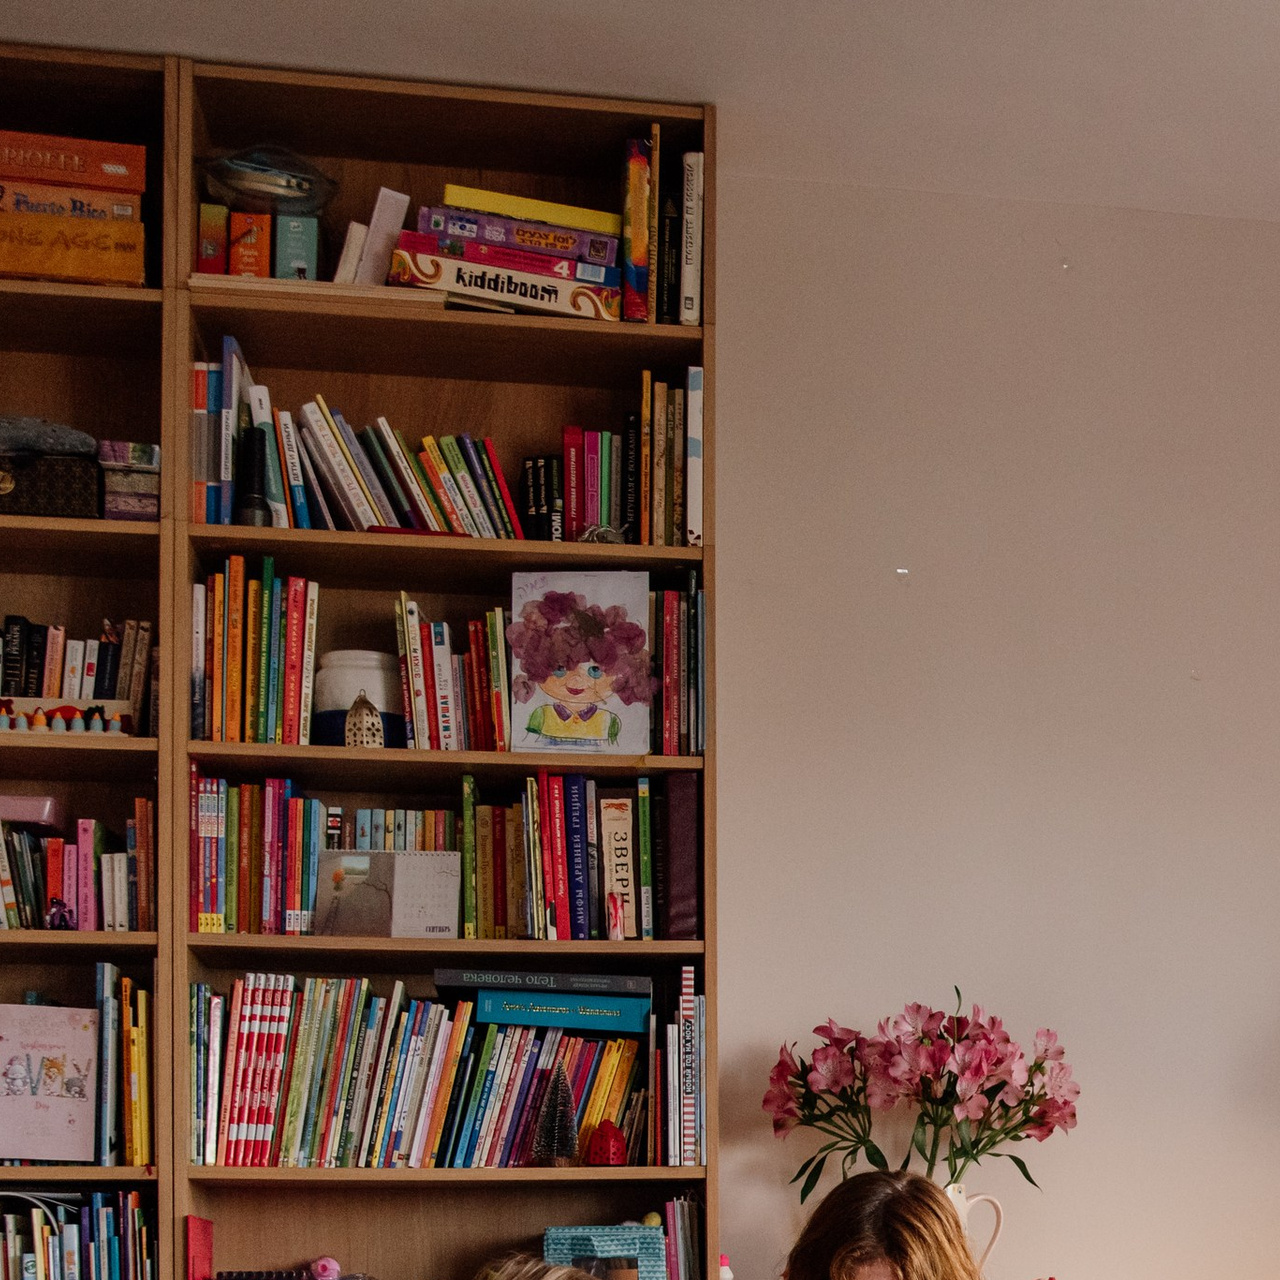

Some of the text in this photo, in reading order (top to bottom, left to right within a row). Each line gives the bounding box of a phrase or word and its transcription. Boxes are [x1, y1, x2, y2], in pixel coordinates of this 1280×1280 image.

[14, 191, 108, 219] Puerto Rico
[553, 260, 570, 277] 4
[283, 423, 294, 453] ДЕНЬГИ
[627, 429, 636, 472] ВОЛКАМИ
[290, 462, 300, 481] ДЕТИ
[627, 481, 636, 522] БЕГУЩАЯ
[413, 655, 421, 679] ЗОКИ
[440, 695, 450, 731] МАРШАК
[570, 785, 584, 924] МИФЫ ДРЕВНЕЙ ГРЕЦИИ
[462, 972, 556, 988] Тело человека
[685, 1042, 692, 1052] НА
